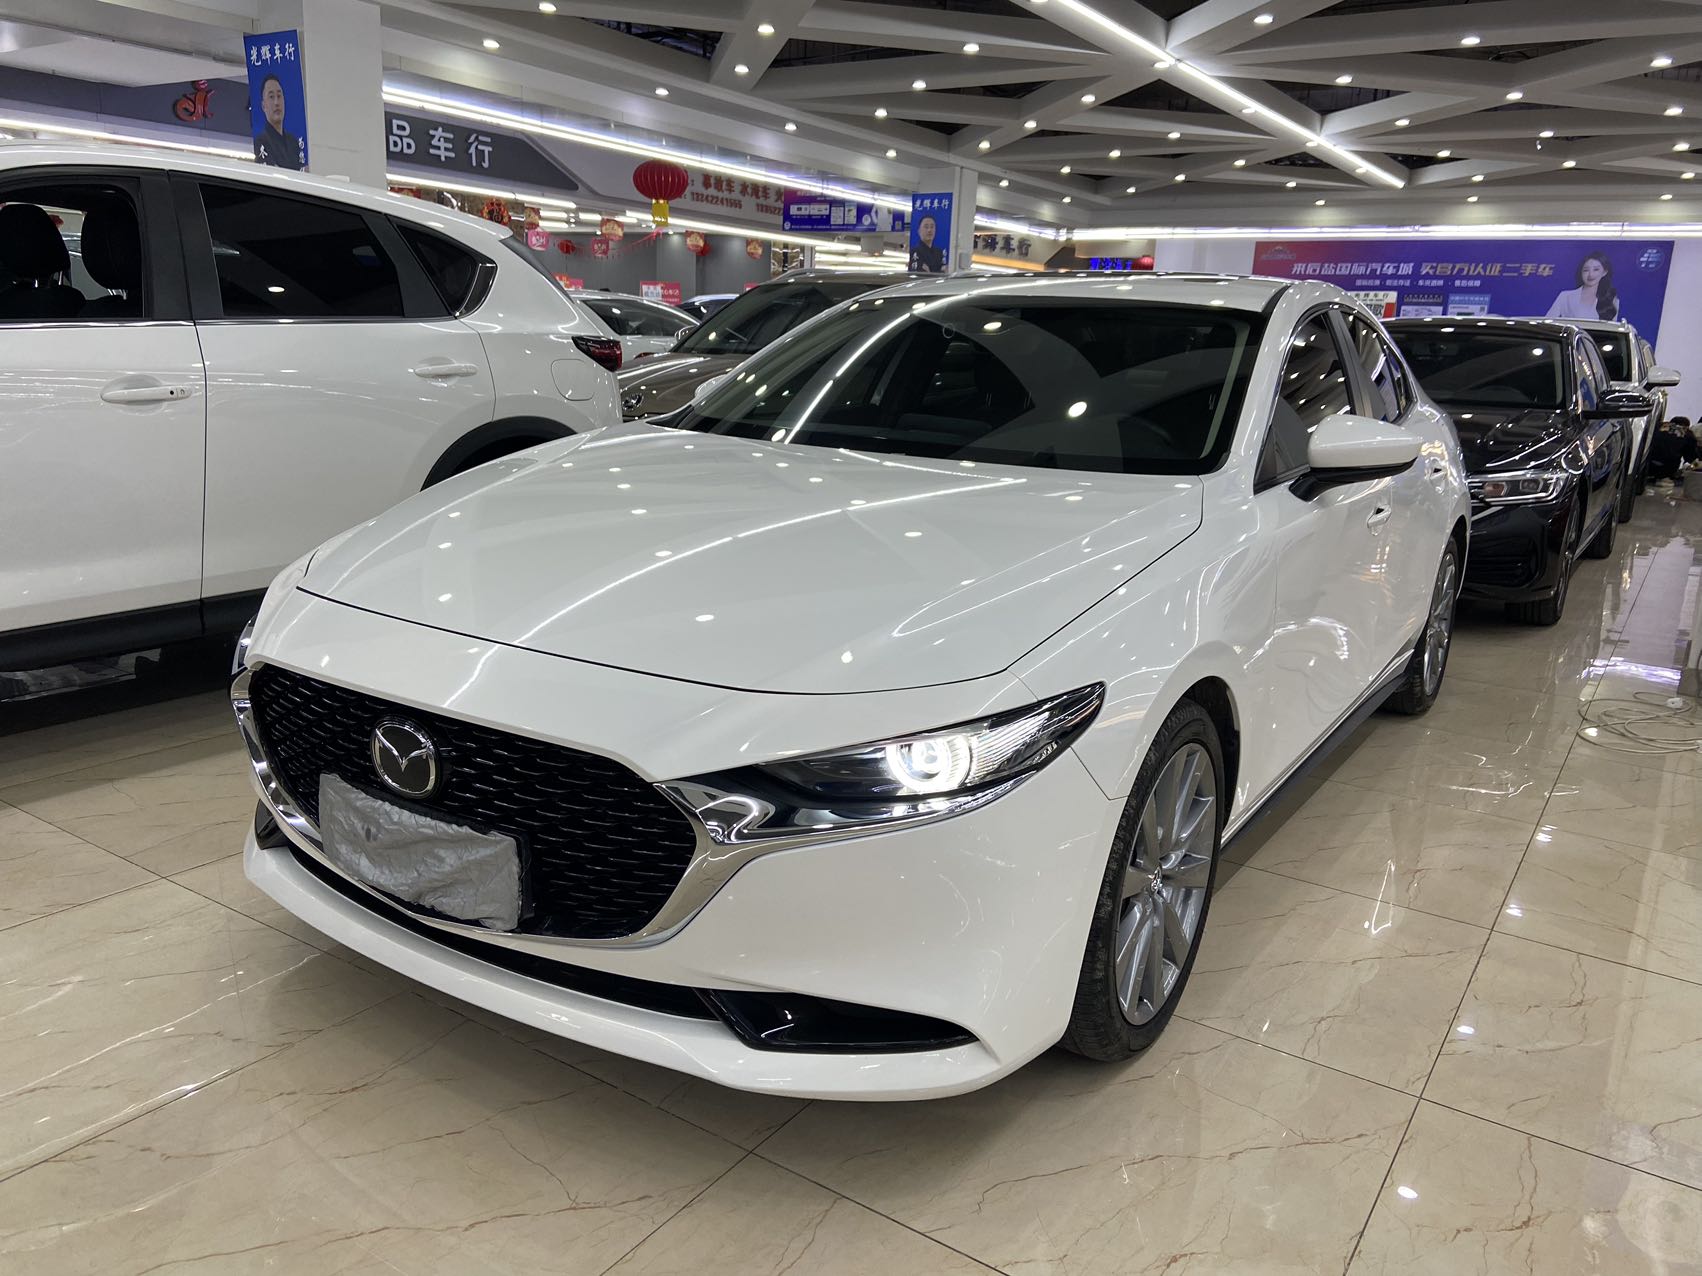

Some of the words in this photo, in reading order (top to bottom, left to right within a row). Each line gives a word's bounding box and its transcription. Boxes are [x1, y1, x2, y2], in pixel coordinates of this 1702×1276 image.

[250, 42, 295, 66] 光辉车行
[389, 119, 493, 168] 品车行
[1420, 262, 1555, 277] 买官方认证二手车
